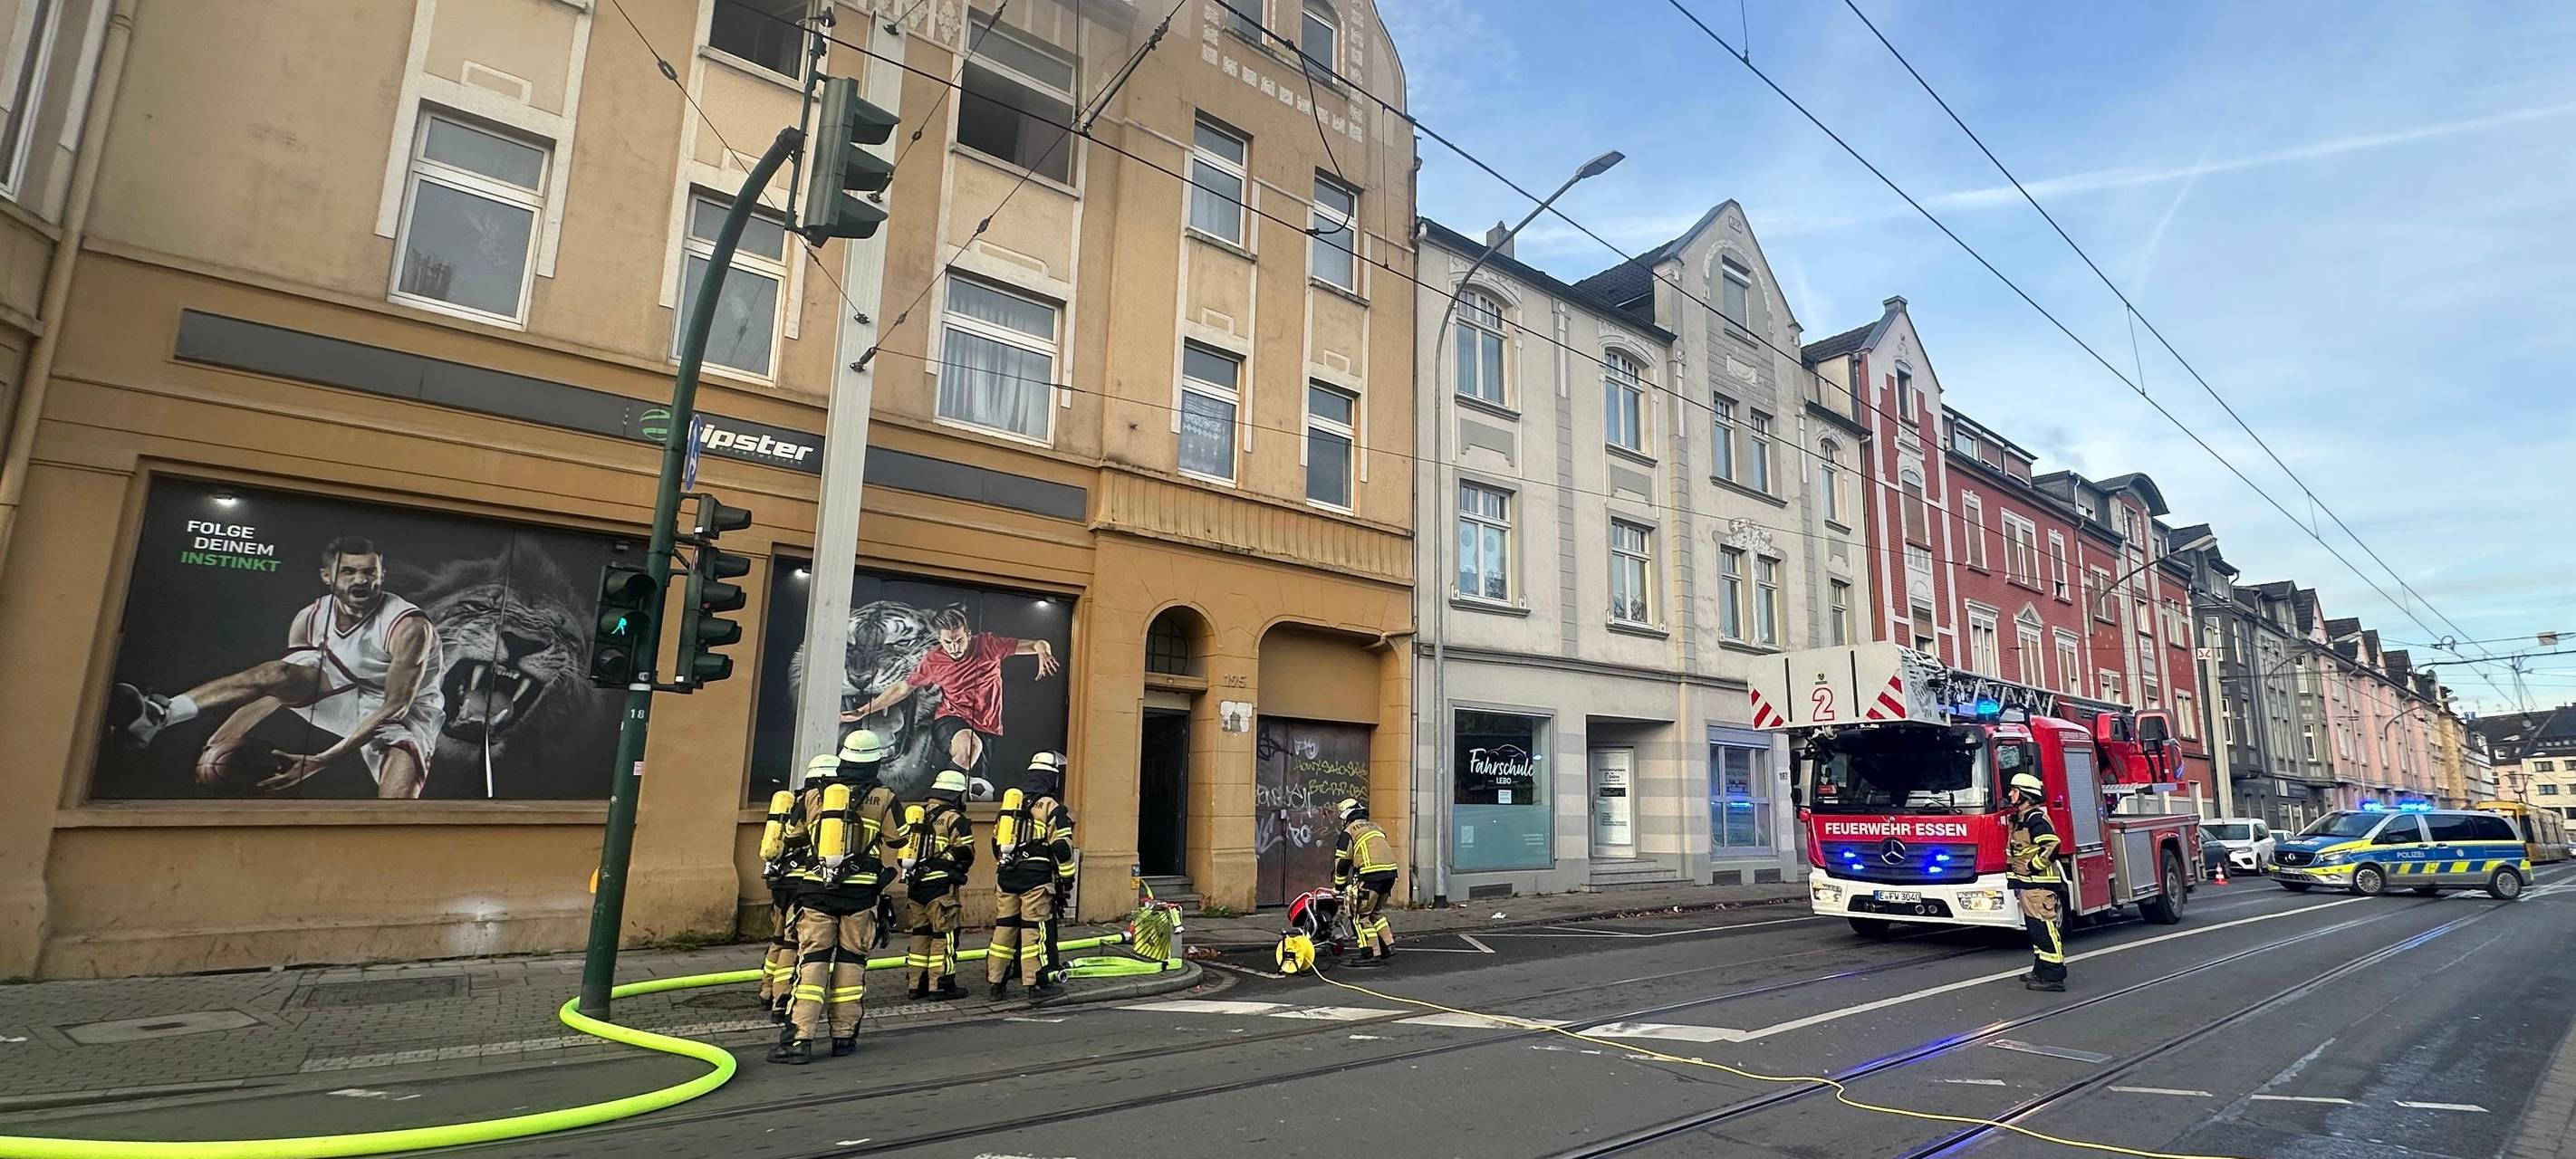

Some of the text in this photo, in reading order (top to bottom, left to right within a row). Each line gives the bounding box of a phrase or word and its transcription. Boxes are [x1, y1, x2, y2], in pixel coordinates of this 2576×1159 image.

[187, 520, 255, 540] FOLGE
[194, 536, 274, 556] DEINEM
[180, 551, 282, 572] INSTINKT
[1223, 674, 1247, 688] 195
[630, 708, 645, 719] 18
[1812, 687, 1835, 723] 2
[1469, 748, 1534, 776] Fahrschule
[1495, 777, 1512, 785] LEBO
[1825, 822, 1967, 837] FEUERWEHR ESSEN
[2396, 850, 2426, 859] POLIZEI
